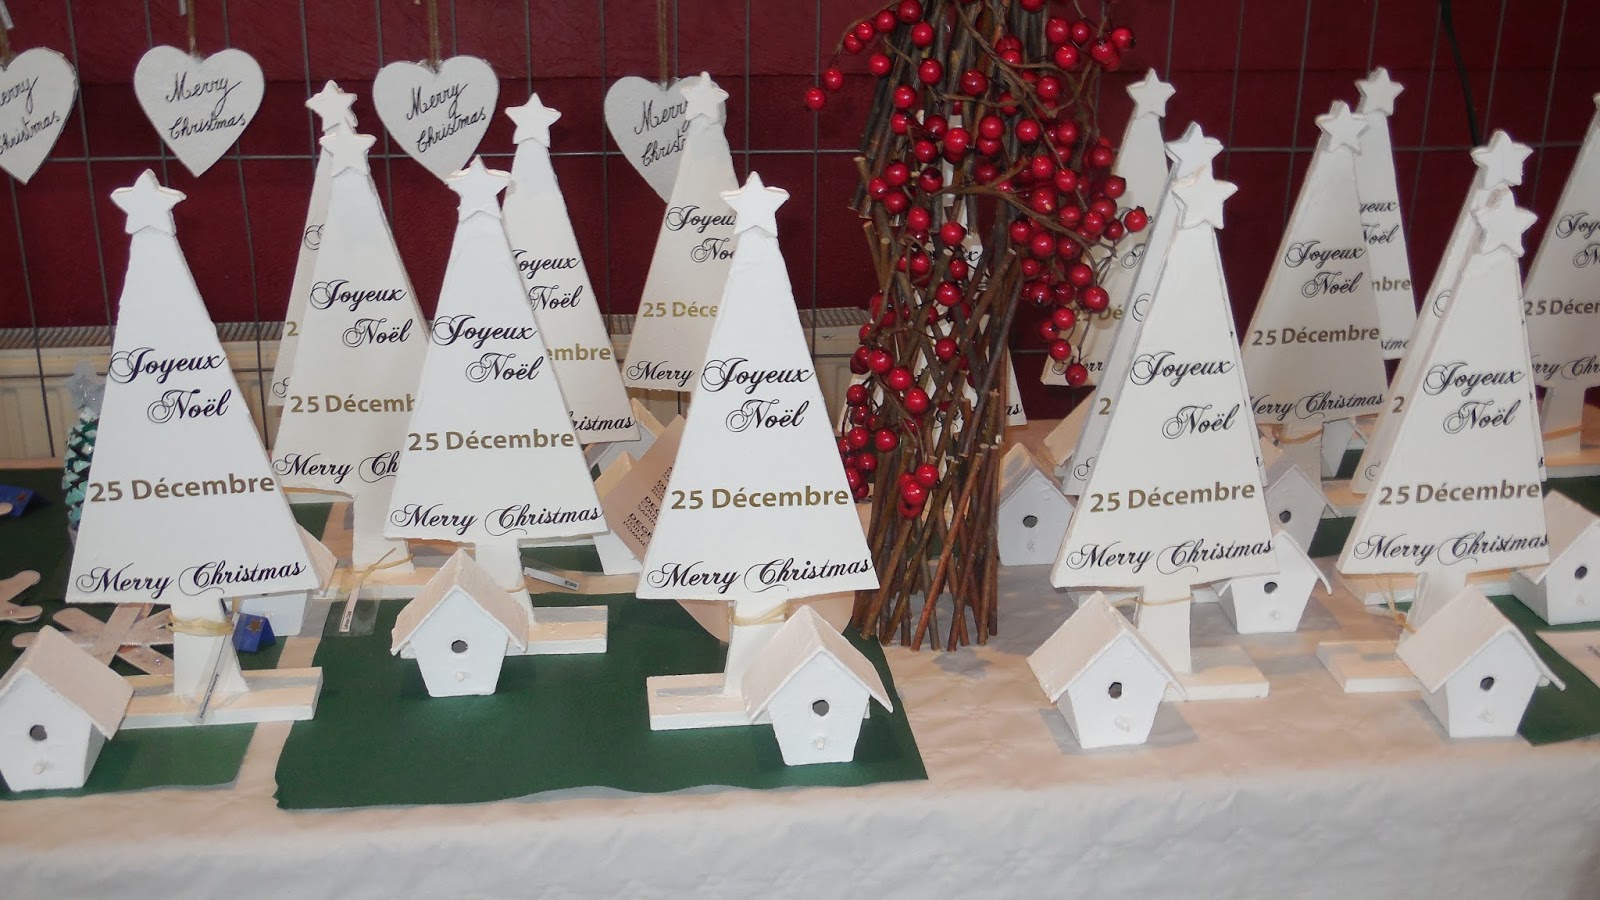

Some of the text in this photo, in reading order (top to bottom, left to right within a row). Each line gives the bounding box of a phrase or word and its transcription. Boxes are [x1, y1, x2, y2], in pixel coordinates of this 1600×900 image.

[0, 76, 39, 115] erry
[166, 71, 242, 118] Merry
[406, 83, 468, 120] Merry
[169, 110, 246, 140] Christmas
[416, 106, 487, 153] Christmas
[634, 100, 690, 135] Merr
[641, 132, 687, 167] Christ
[1360, 202, 1399, 213] yeux
[1284, 240, 1366, 269] Joyeux
[310, 279, 407, 311] Joyeux
[1301, 271, 1364, 298] Noël
[643, 301, 718, 318] 25 Déce
[1524, 300, 1546, 316] 25
[286, 321, 299, 337] 2
[342, 317, 413, 348] Noël
[431, 314, 538, 349] Joyeux
[1252, 325, 1380, 346] 25 Décembre
[108, 347, 226, 384] Joyeux
[465, 352, 544, 383] Noël
[626, 361, 695, 387] Merry
[701, 357, 814, 394] Joyeux
[1130, 351, 1235, 387] Joyeux
[1423, 362, 1526, 397] Joyeux
[147, 389, 232, 424] Noël
[290, 393, 415, 413] 25 Décemb
[725, 398, 810, 433] Noël
[1098, 398, 1112, 416] 2
[1294, 391, 1385, 419] Christmas
[1392, 396, 1405, 413] 2
[1443, 400, 1522, 434] Noël
[1162, 404, 1241, 440] Noël
[408, 429, 575, 451] 25 Décembre
[272, 453, 354, 484] Merry
[89, 473, 275, 502] 25 Décembre
[671, 485, 849, 510] 25 Décembre
[1090, 481, 1255, 513] 25 Décembre
[1378, 480, 1540, 506] 25 Décembre
[390, 503, 605, 537] Merry Christmas
[1066, 538, 1275, 575] Merry Christmas
[1353, 531, 1549, 566] Merry Christmas
[76, 559, 307, 599] Merry Christmas
[647, 558, 872, 594] Merry Christmas
